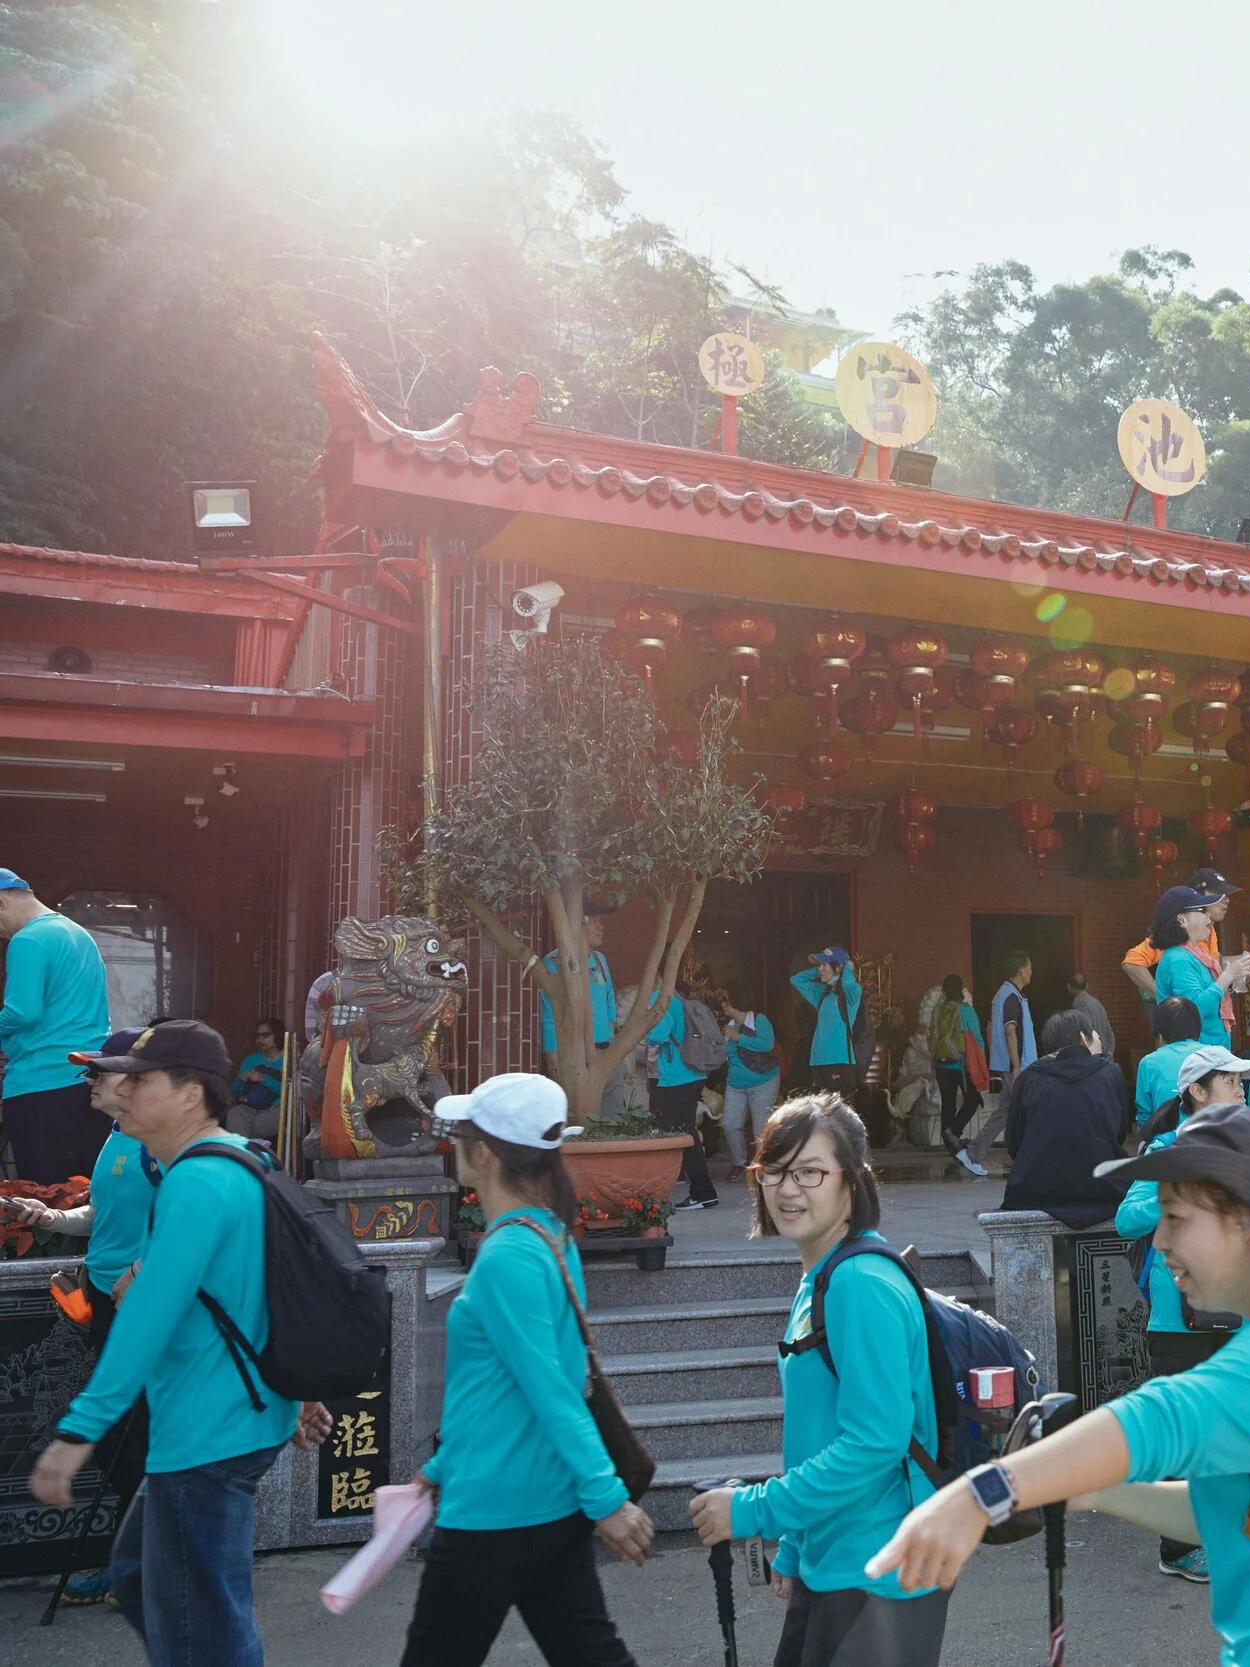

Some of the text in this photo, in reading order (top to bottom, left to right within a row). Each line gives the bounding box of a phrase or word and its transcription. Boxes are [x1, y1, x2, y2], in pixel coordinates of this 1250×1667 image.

[708, 337, 755, 388] 極
[857, 353, 921, 434] 宮
[1134, 412, 1195, 483] 池
[331, 1391, 382, 1513] 蒞臨
